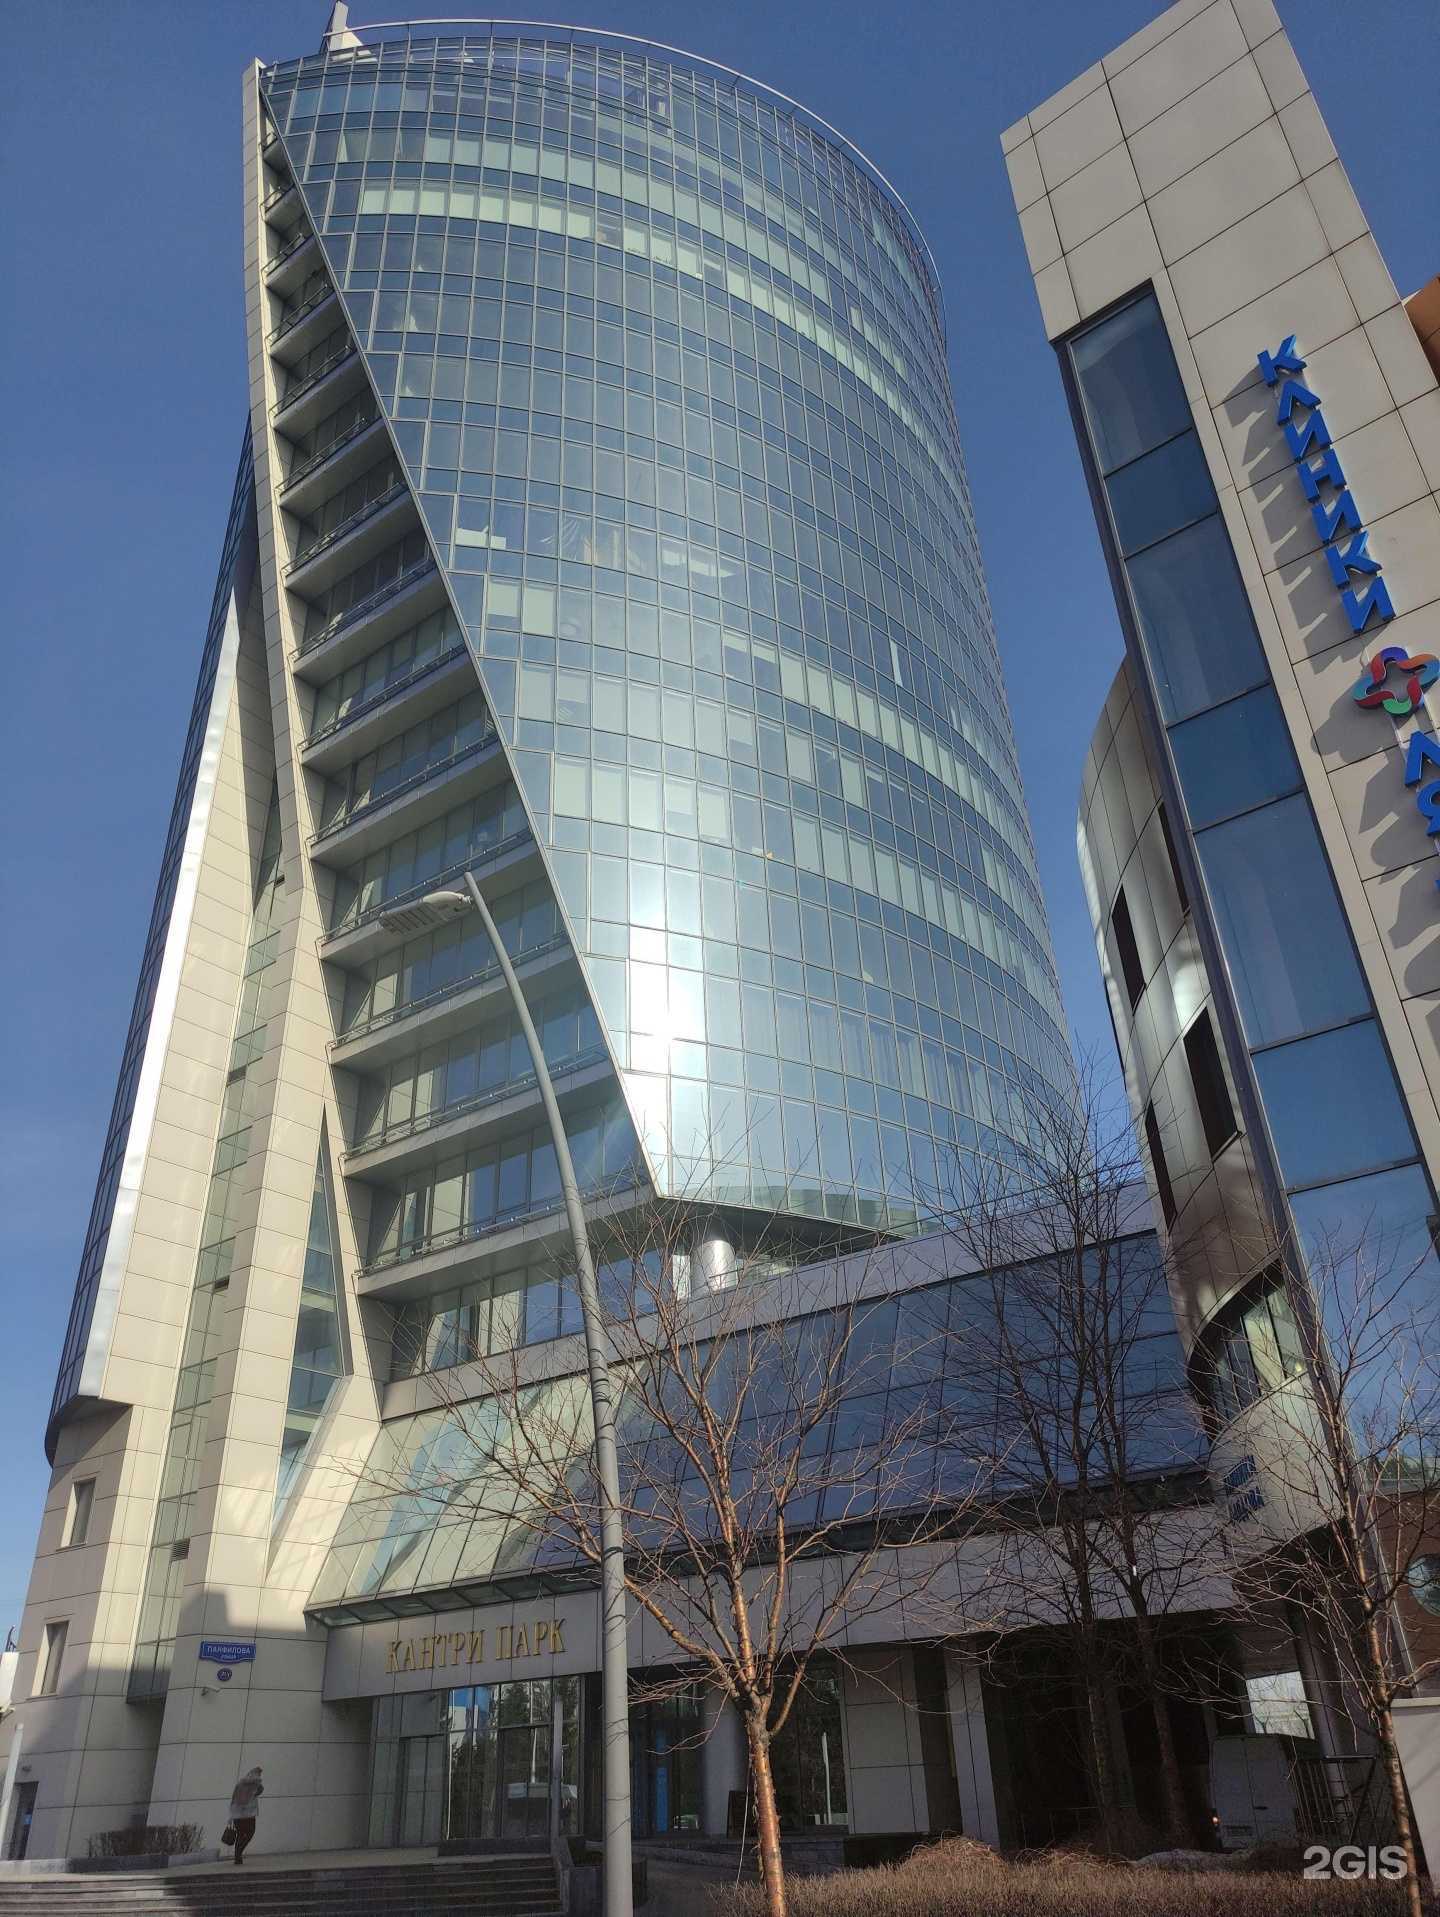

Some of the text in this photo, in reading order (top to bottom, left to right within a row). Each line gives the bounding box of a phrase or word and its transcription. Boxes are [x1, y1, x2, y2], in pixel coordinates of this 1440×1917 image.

[1257, 333, 1440, 893] КЛИНИКИ ЛЯ
[207, 1645, 251, 1655] ПАНФИЛОВА
[385, 1618, 567, 1674] КАНТРИ ПАРК
